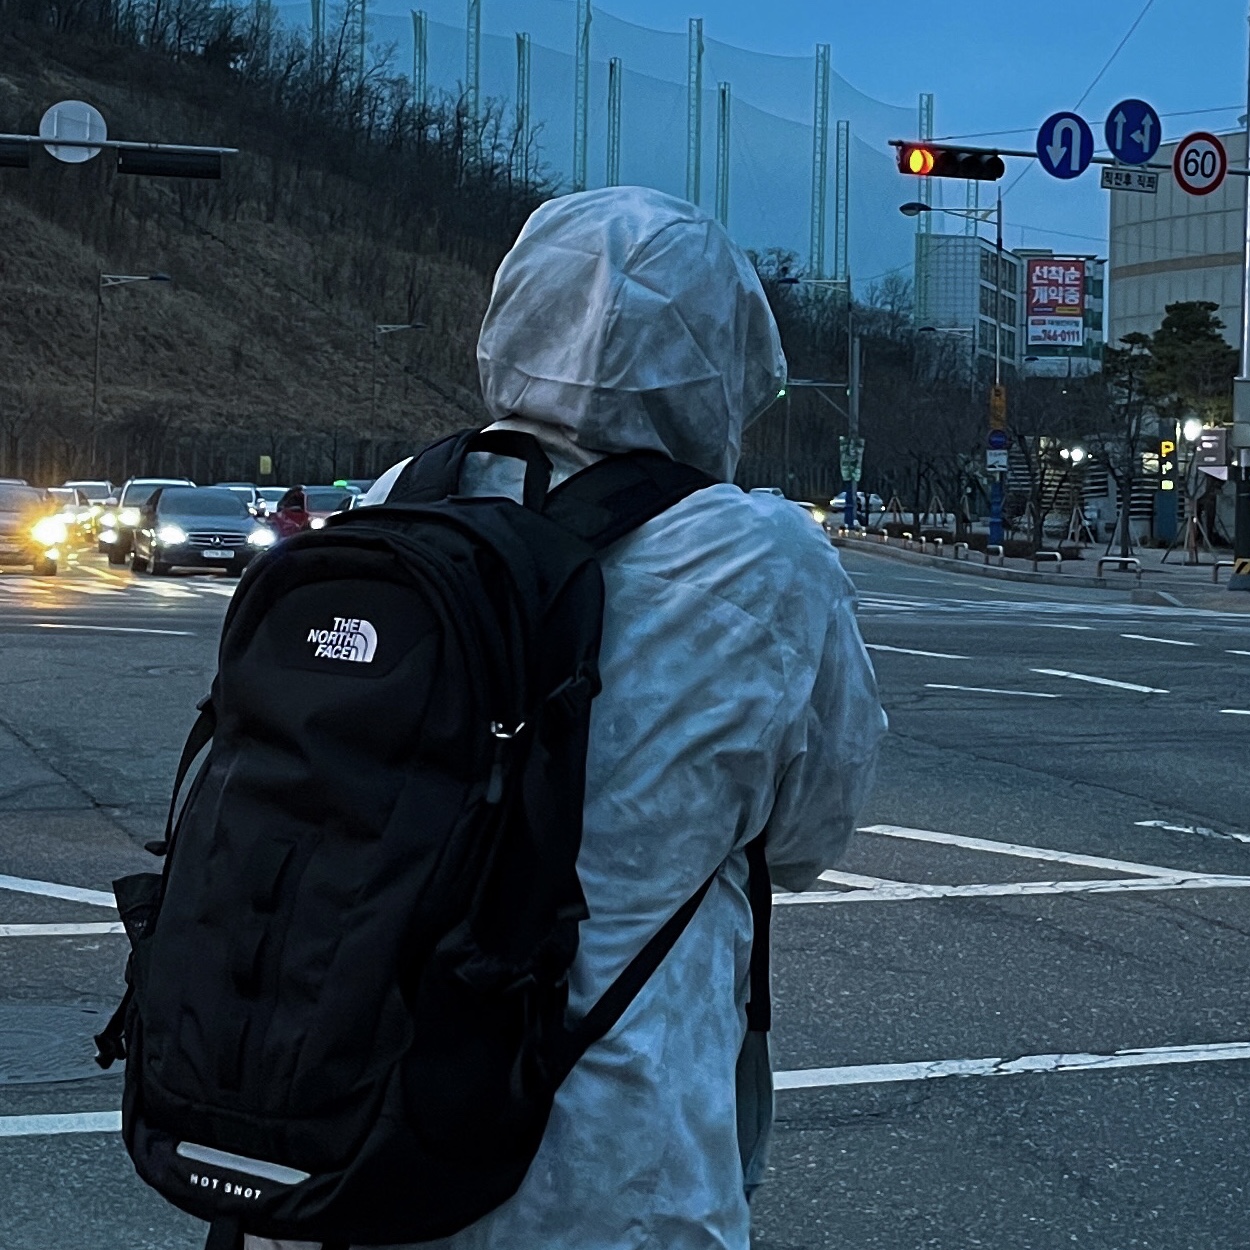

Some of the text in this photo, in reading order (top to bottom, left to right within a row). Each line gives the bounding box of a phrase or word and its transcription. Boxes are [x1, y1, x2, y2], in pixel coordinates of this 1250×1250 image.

[1183, 148, 1217, 179] 60
[1032, 265, 1081, 284] 선착순
[1031, 286, 1080, 304] 계약중
[333, 617, 360, 632] THE
[306, 629, 357, 647] NORTH
[314, 644, 352, 660] FACE
[189, 1173, 219, 1190] HOT
